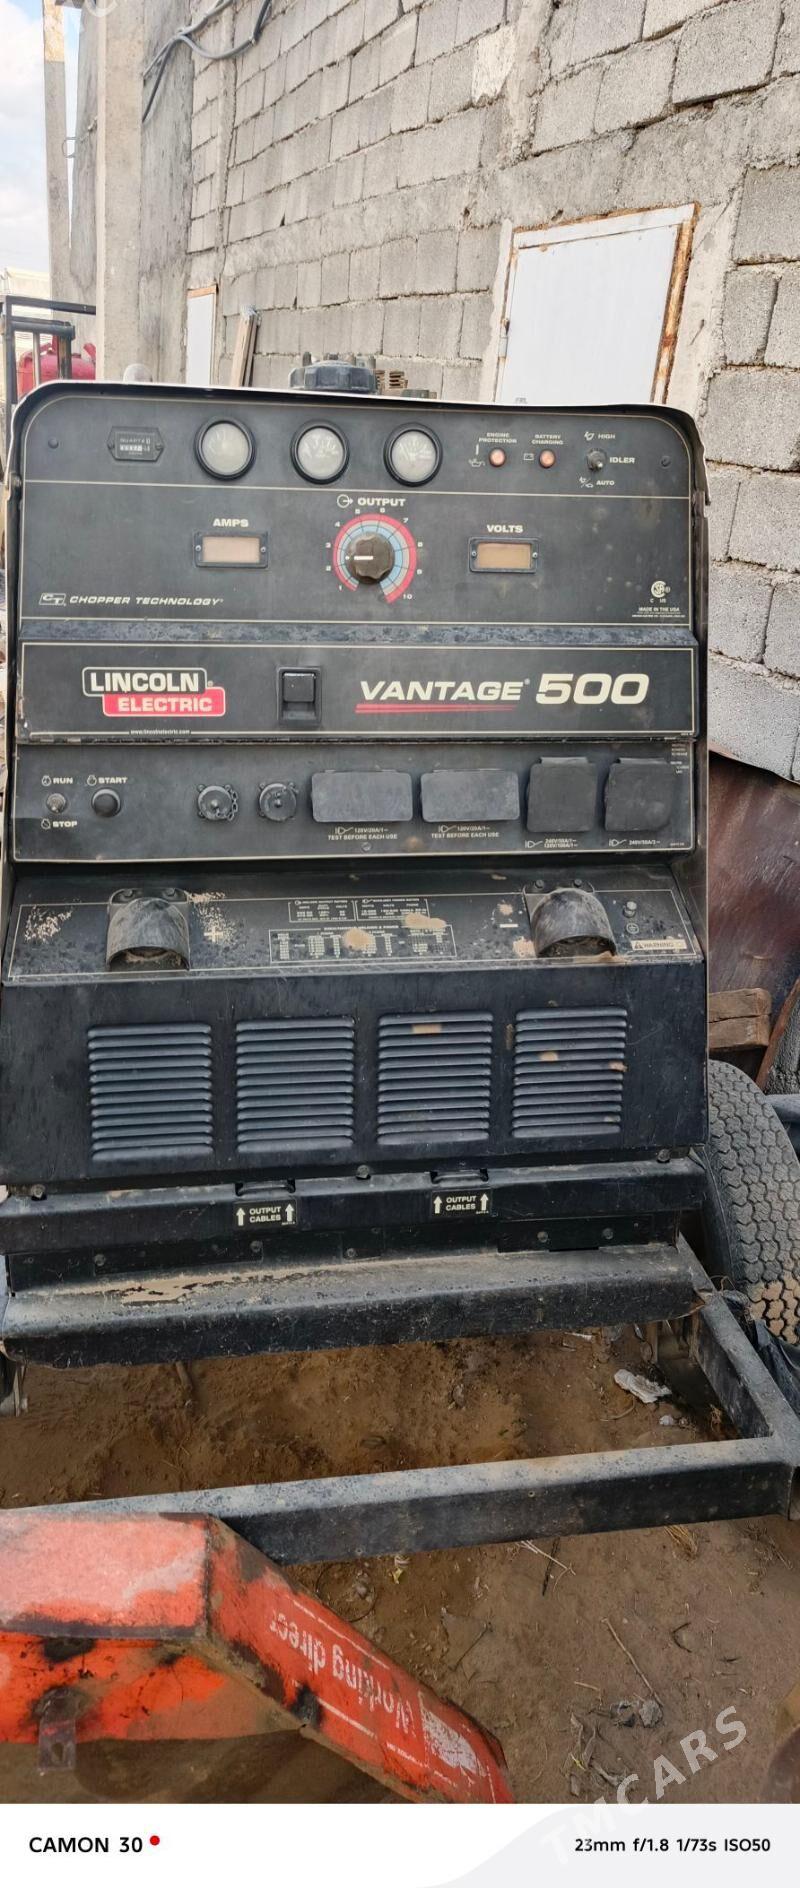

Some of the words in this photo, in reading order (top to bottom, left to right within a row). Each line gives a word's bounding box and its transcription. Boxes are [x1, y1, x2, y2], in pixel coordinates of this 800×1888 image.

[609, 456, 635, 464] IDLER
[357, 497, 406, 507] OUTPUT
[212, 518, 249, 527] AMPS
[486, 524, 524, 533] VOLTS
[69, 595, 130, 604] CHOPPER
[90, 672, 199, 692] LINCOLN
[360, 680, 524, 700] VANTAGE
[535, 673, 650, 705] 500
[117, 697, 213, 712] ELECTRIC
[52, 820, 78, 828] STOP
[446, 1195, 477, 1204] OUTPUT
[249, 1206, 281, 1215] OUTPUT
[445, 1203, 476, 1211] CABLES
[249, 1214, 281, 1223] CABLES
[332, 1643, 416, 1738] Working
